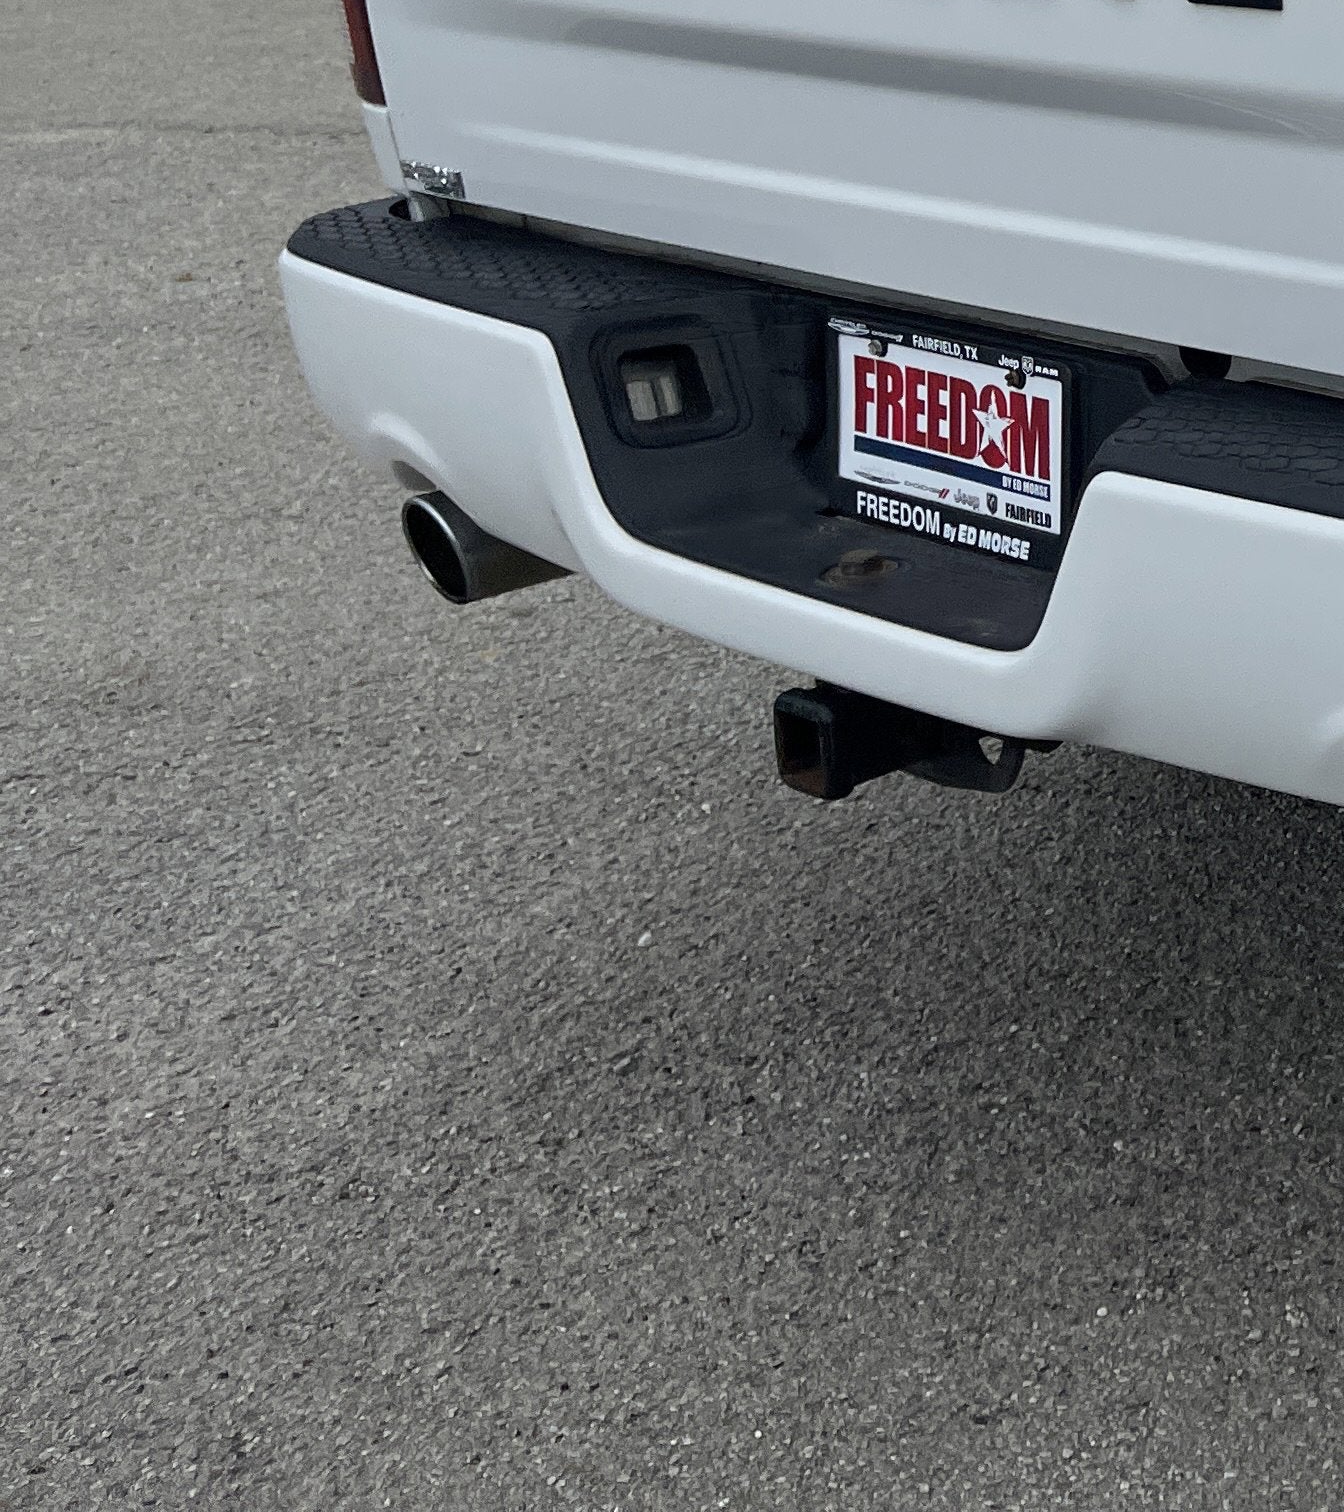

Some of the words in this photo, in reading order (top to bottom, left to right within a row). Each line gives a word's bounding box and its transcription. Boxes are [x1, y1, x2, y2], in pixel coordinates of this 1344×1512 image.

[965, 346, 978, 361] TX
[998, 354, 1020, 370] Jeep
[1035, 365, 1059, 377] RAM
[853, 354, 1050, 482] FREEDOM
[1002, 475, 1012, 488] BY
[1012, 477, 1022, 492] ED
[1023, 480, 1049, 499] MORSE
[953, 488, 981, 510] Jeep
[856, 490, 941, 536] FREEDOM
[957, 524, 977, 545] ED
[978, 529, 1031, 561] MORSE
[1005, 502, 1051, 528] FAIRFIELD
